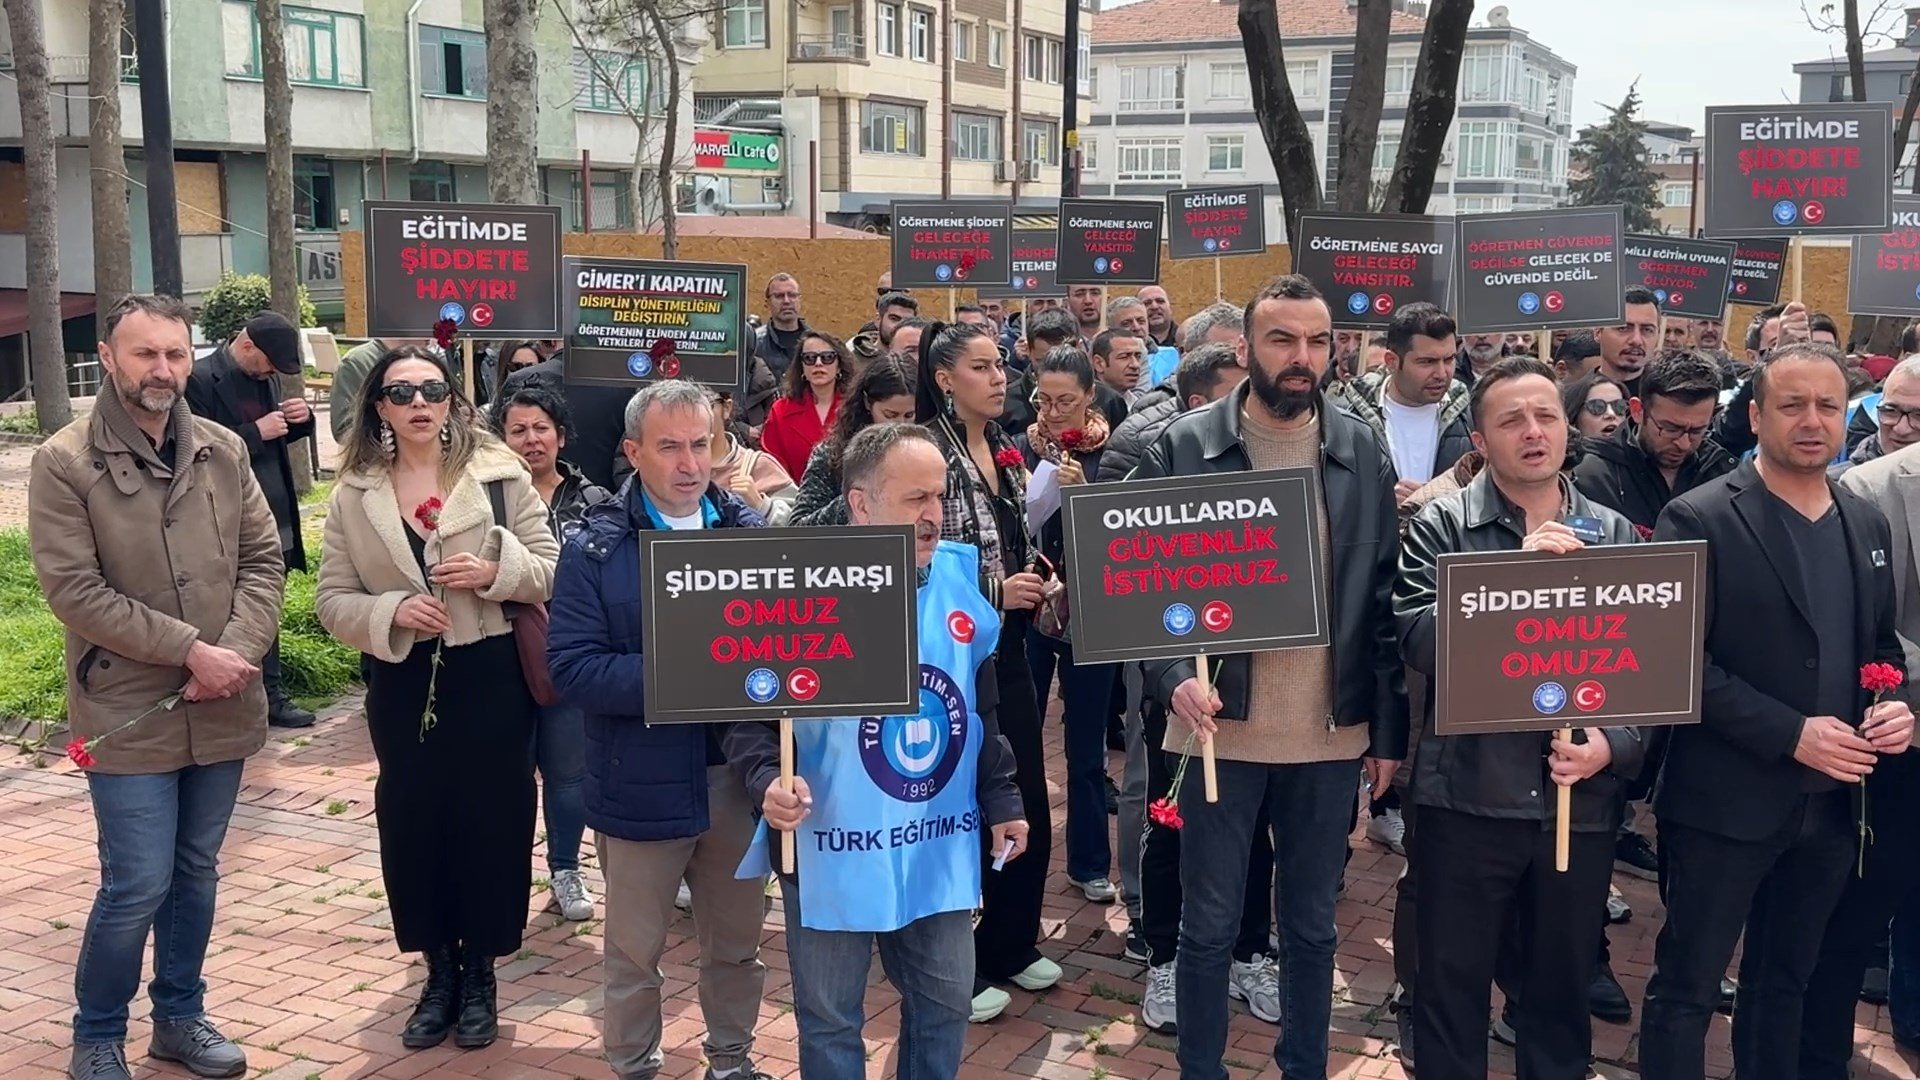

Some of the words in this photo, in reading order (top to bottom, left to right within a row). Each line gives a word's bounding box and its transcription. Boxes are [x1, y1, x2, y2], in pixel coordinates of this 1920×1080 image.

[1740, 117, 1859, 140] EĞİTİMDE
[1739, 143, 1862, 176] ŞİDDETE
[1751, 176, 1848, 199] HAYIR!
[1184, 193, 1247, 208] EĞİTİMDE
[402, 216, 527, 241] EĞİTİMDE
[899, 217, 964, 227] ÖĞRETMENE
[967, 217, 1005, 229] ŞİDDET
[1069, 217, 1125, 229] ÖĞRETMENE
[1126, 221, 1153, 230] SAYGI
[401, 242, 529, 275] ŞİDDETE
[1310, 237, 1398, 253] ÖĞRETMENE
[1401, 242, 1443, 255] SAYGI
[1625, 246, 1651, 257] MİLLİ
[1690, 255, 1726, 265] UYUMA
[308, 251, 342, 280] AS
[1529, 253, 1590, 267] GELECEK
[1593, 252, 1612, 263] DE
[650, 275, 728, 297] KAPATIN,
[1333, 272, 1414, 287] YANSITIR.
[1484, 272, 1550, 286] GÜVENDE
[1554, 267, 1599, 282] DEĞİL.
[416, 278, 516, 301] HAYIR!
[1103, 497, 1278, 529] OKULLARDA
[1108, 521, 1278, 562] GÜVENLİK
[665, 563, 795, 598] ŞİDDETE
[805, 565, 892, 592] KARŞI
[1104, 559, 1288, 596] İSTİYORUZ.
[724, 597, 839, 626] OMUZ
[1460, 585, 1586, 618] ŞİDDETE
[1595, 582, 1682, 608] KARŞI
[1515, 614, 1628, 644] OMUZ
[710, 633, 854, 663] OMUZA
[1501, 648, 1639, 677] OMUZA
[902, 778, 936, 797] 1992
[814, 828, 884, 852] TÜRK
[890, 809, 980, 848] EĞİTİM-SE
